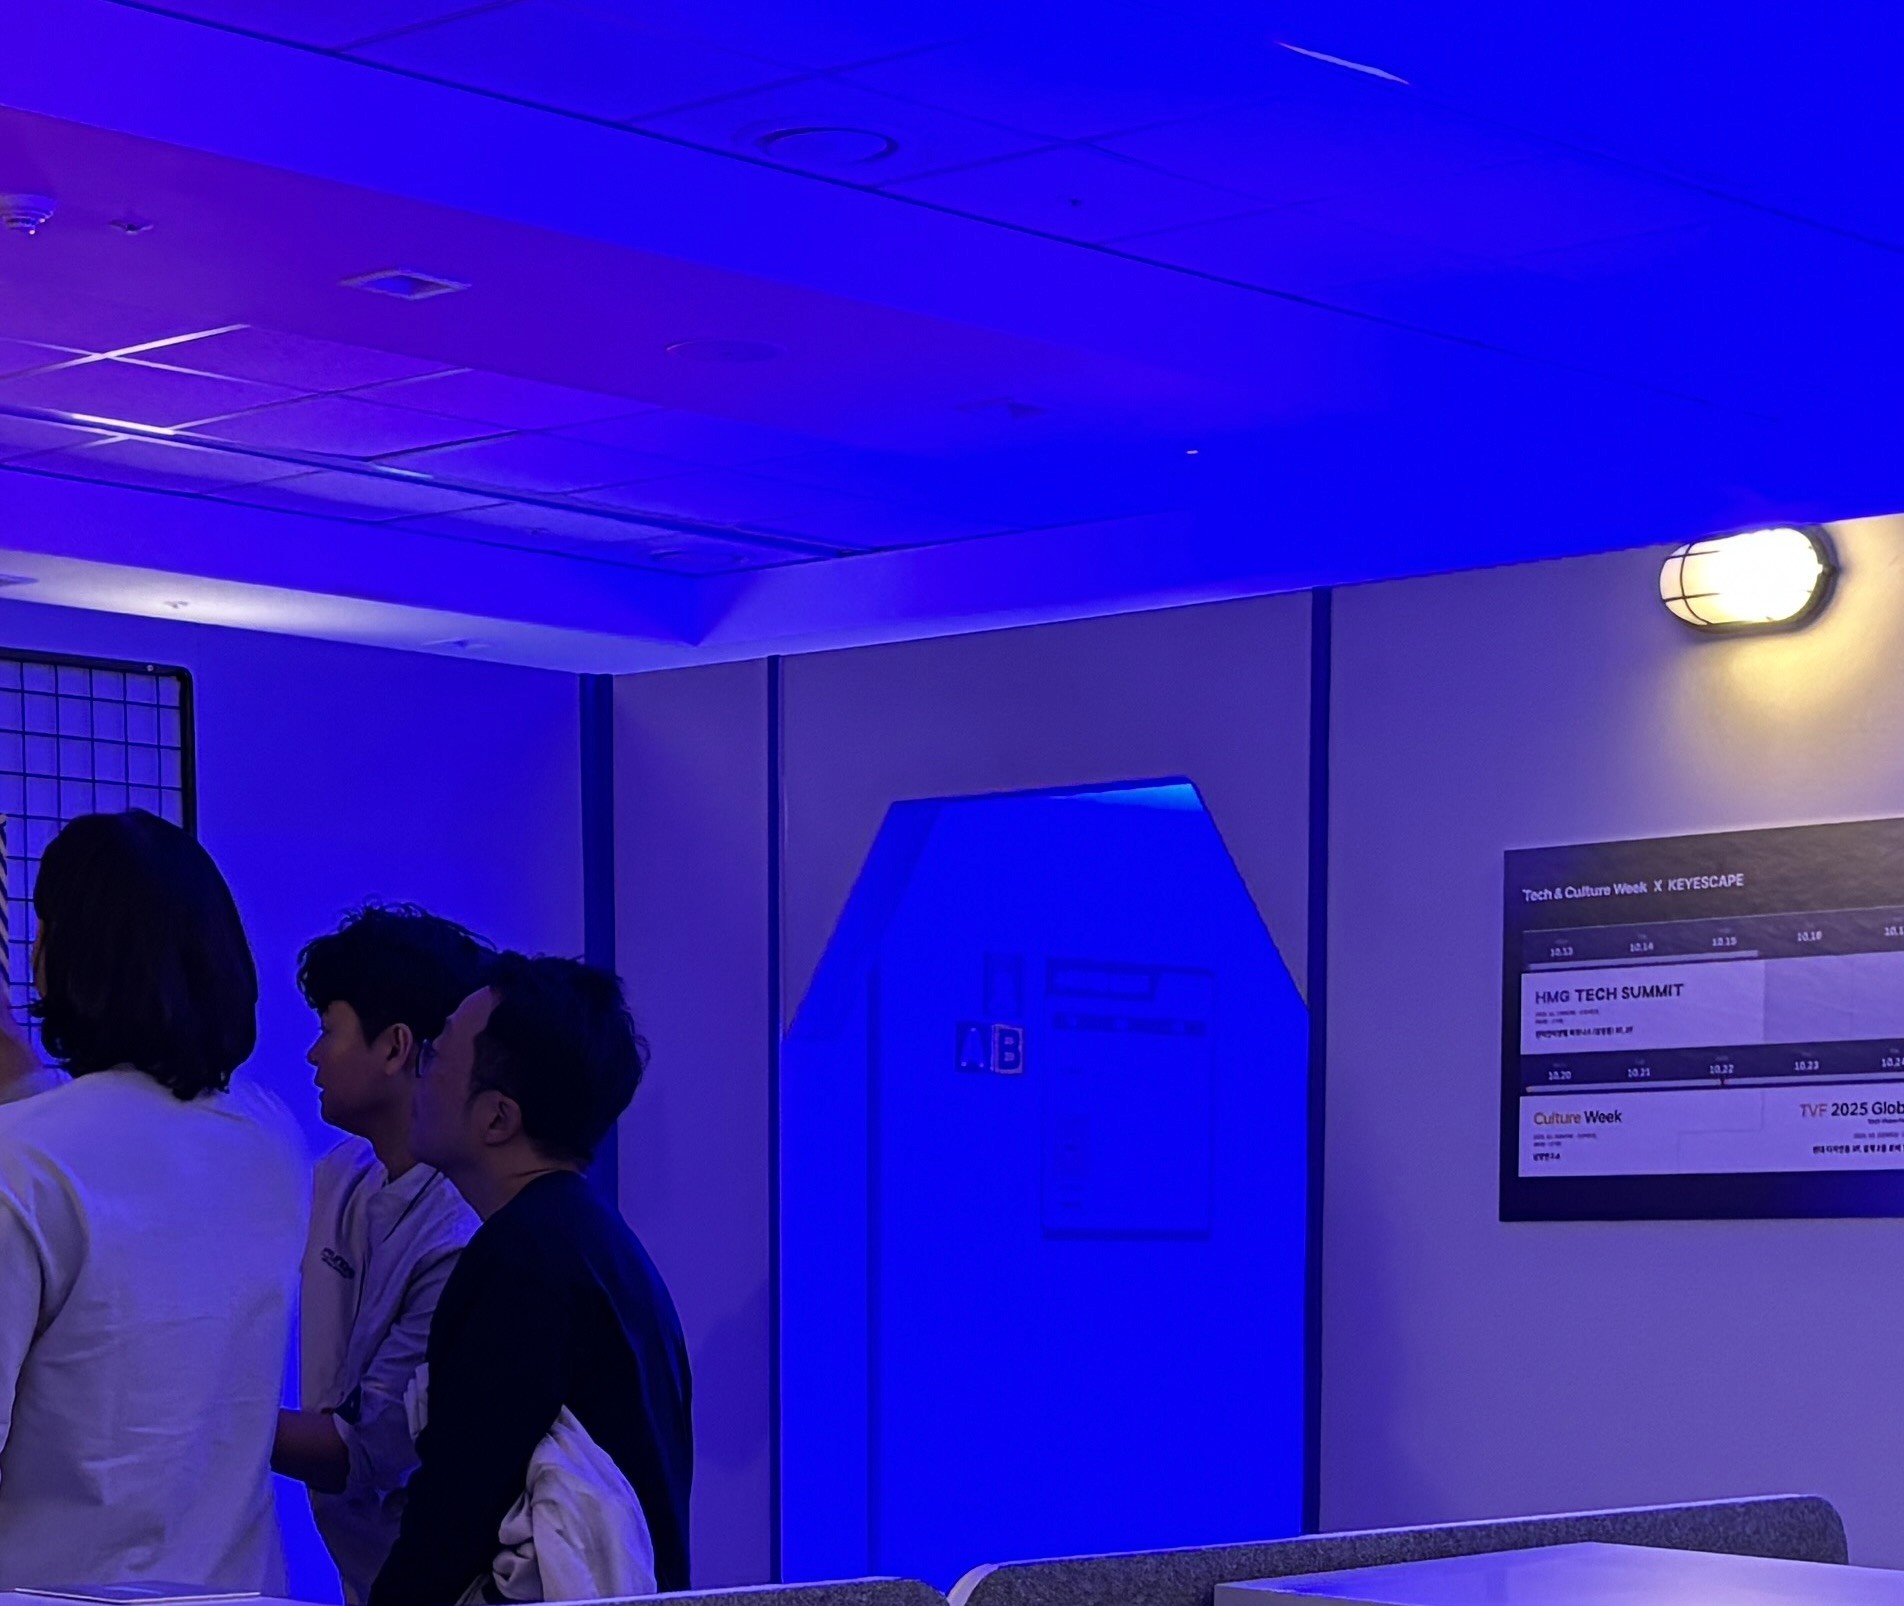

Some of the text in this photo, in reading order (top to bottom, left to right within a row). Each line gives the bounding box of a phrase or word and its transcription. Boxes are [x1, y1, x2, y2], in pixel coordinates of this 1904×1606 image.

[1522, 887, 1553, 902] Tech
[1554, 889, 1562, 900] &
[1565, 885, 1611, 899] Culture
[1613, 881, 1647, 895] Week
[1668, 873, 1744, 891] KEYESCAPE
[1535, 983, 1684, 1004] HMG TECH SUMMIT
[997, 1026, 1022, 1067] B
[1534, 1109, 1623, 1126] Culture Week
[1800, 1103, 1828, 1117] TVF
[1831, 1102, 1868, 1116] 2025
